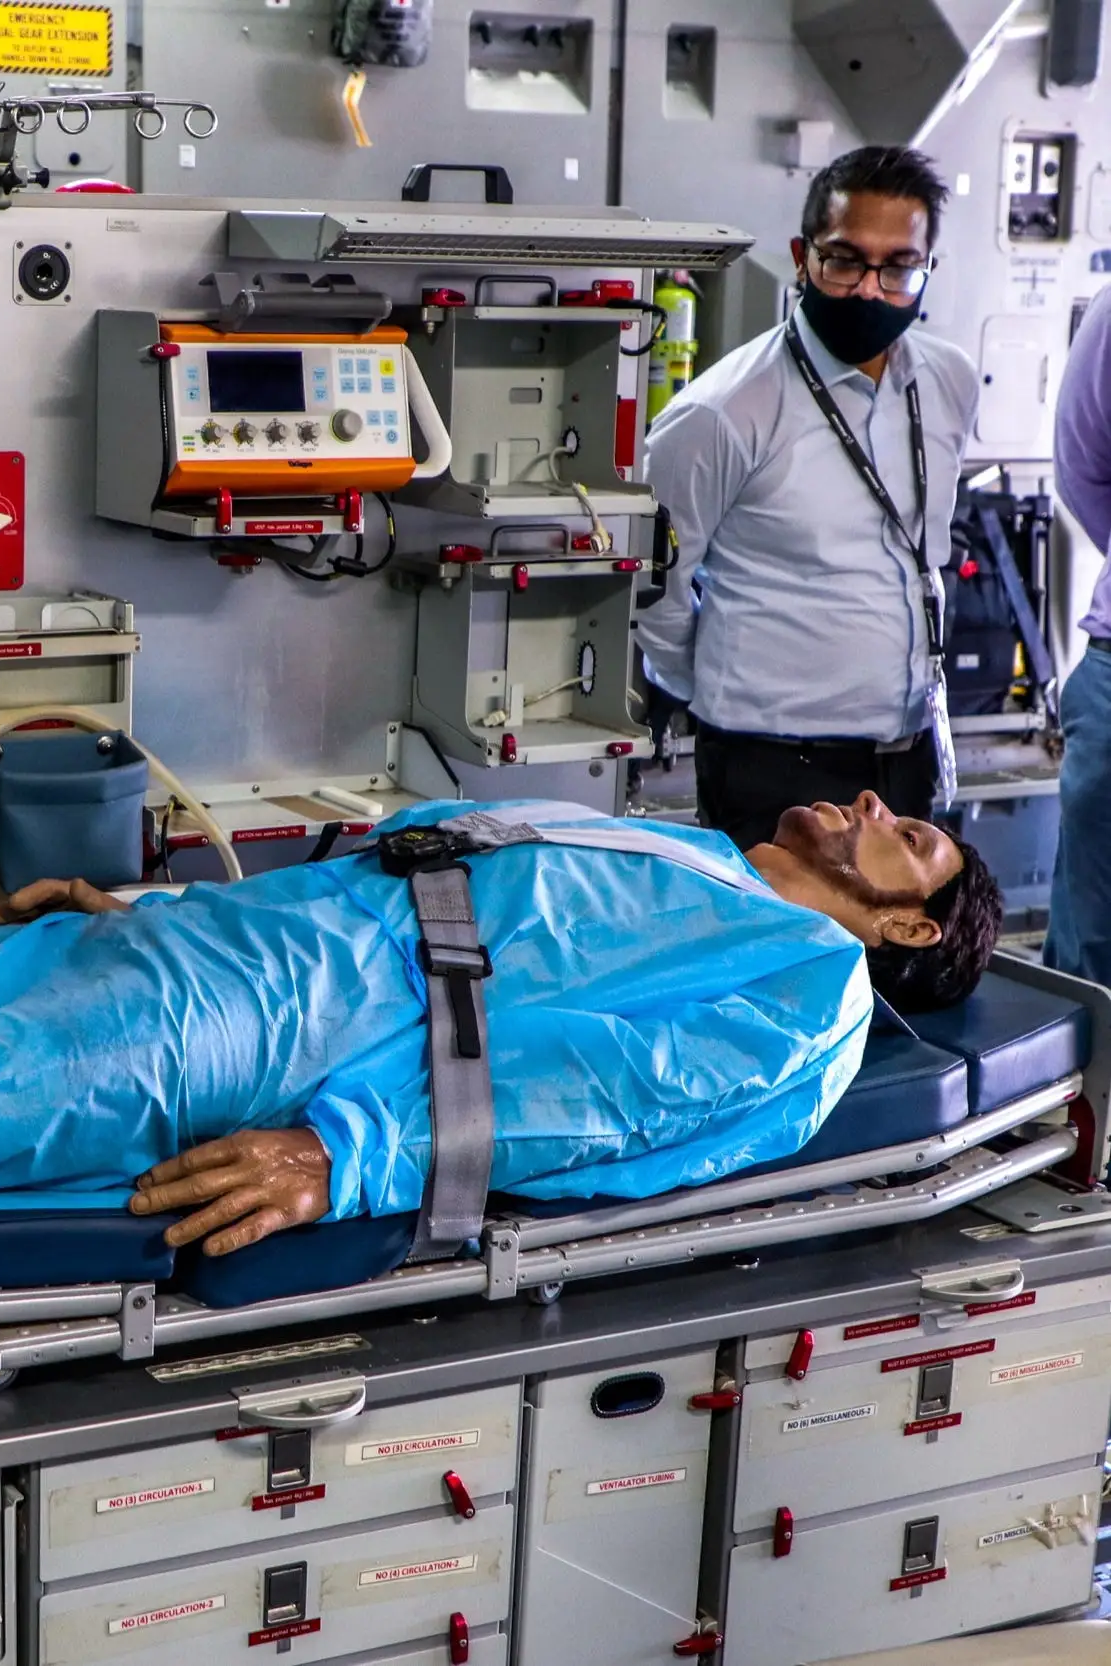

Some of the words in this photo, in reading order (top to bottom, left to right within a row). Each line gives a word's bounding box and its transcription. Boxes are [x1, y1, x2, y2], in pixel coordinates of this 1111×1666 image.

[9, 13, 64, 24] EMERGENCY
[20, 28, 42, 38] GEAR
[48, 29, 99, 41] EXTENSION
[378, 1446, 390, 1454] NO
[392, 1444, 402, 1453] (3)
[404, 1436, 462, 1451] CIRCULATION-1
[599, 1478, 645, 1490] VENTALATOR
[648, 1473, 675, 1483] TUBING
[109, 1499, 123, 1508] NO
[125, 1497, 136, 1506] (3)
[139, 1483, 202, 1502] CIRCULATION-1
[376, 1572, 387, 1580] NO
[390, 1570, 399, 1578] (4)
[401, 1560, 459, 1575] CIRCULATION-2
[122, 1620, 134, 1628] NO
[137, 1616, 148, 1626] (4)
[150, 1600, 213, 1621] CIRCULATION-2
